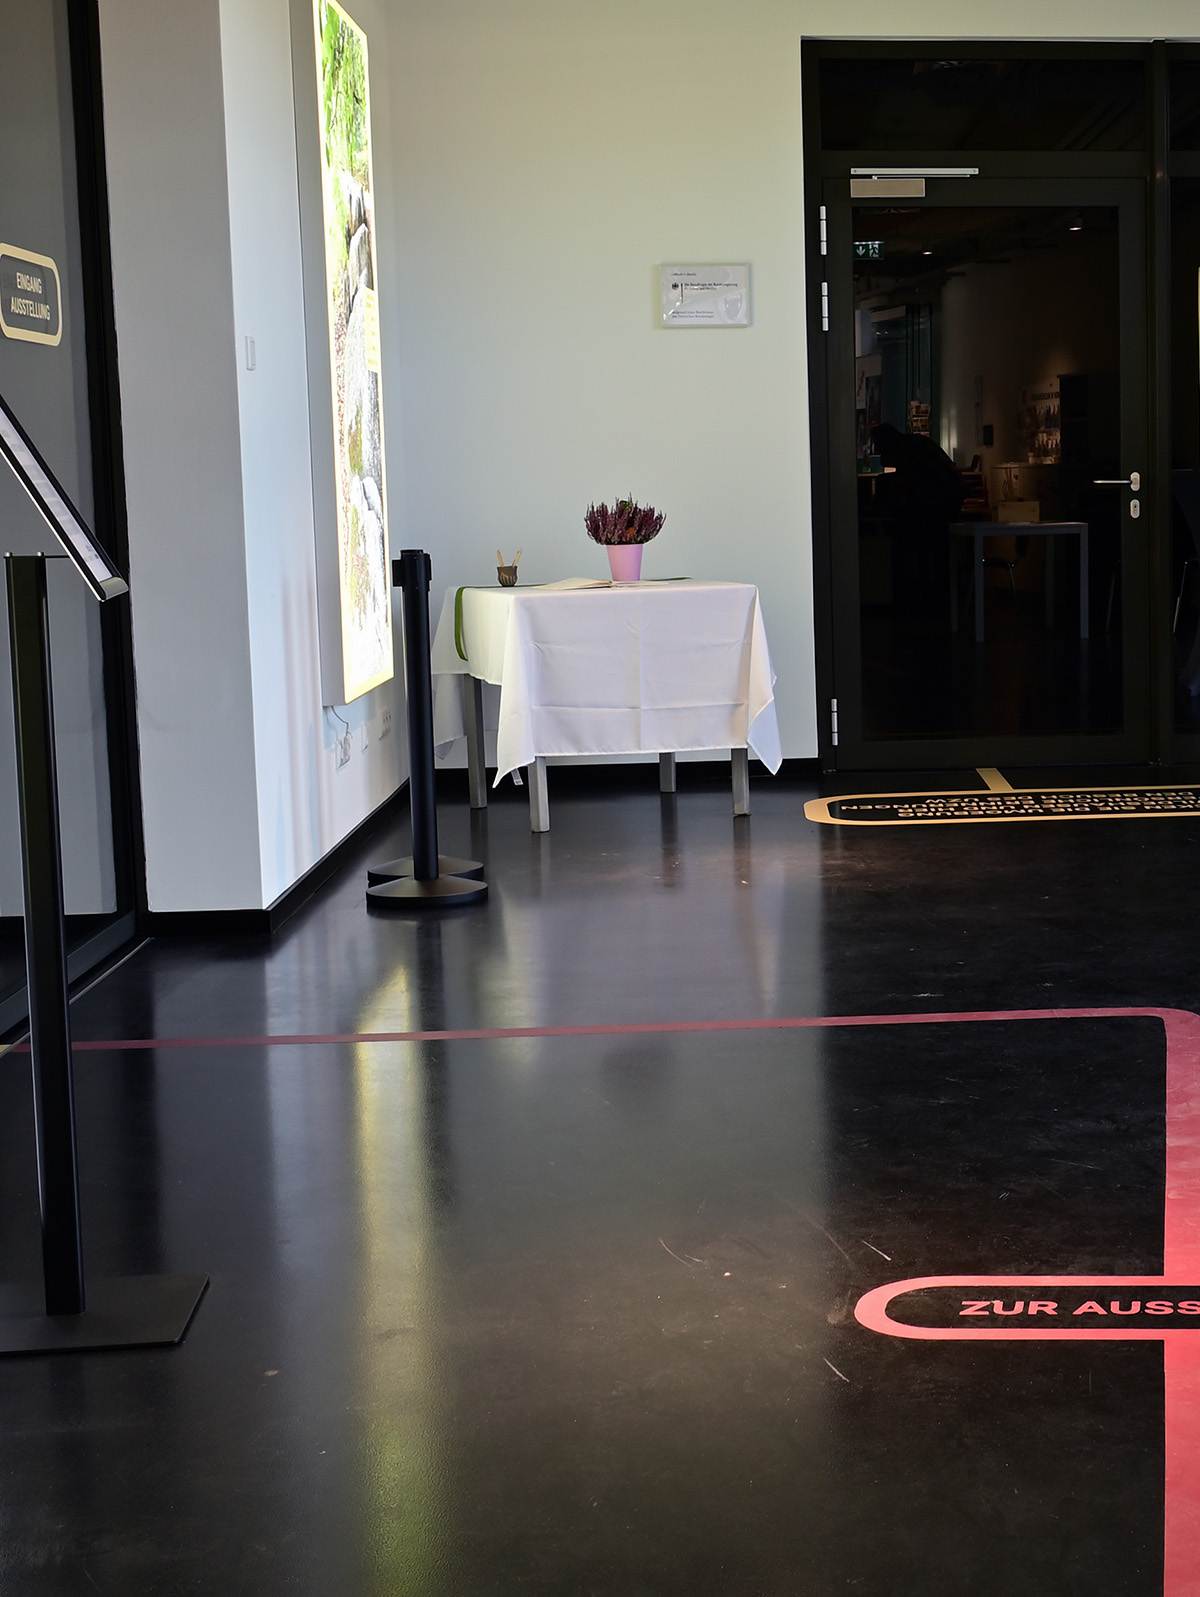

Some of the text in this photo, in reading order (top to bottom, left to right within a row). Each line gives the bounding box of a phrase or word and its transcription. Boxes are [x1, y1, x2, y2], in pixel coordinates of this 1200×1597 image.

[16, 272, 42, 294] EINGANG
[11, 297, 50, 320] AUSSTELLUNG
[841, 800, 1033, 810] ERINNERUNGEN
[897, 809, 1042, 817] UMGEBUNG
[960, 1300, 1058, 1316] ZUR
